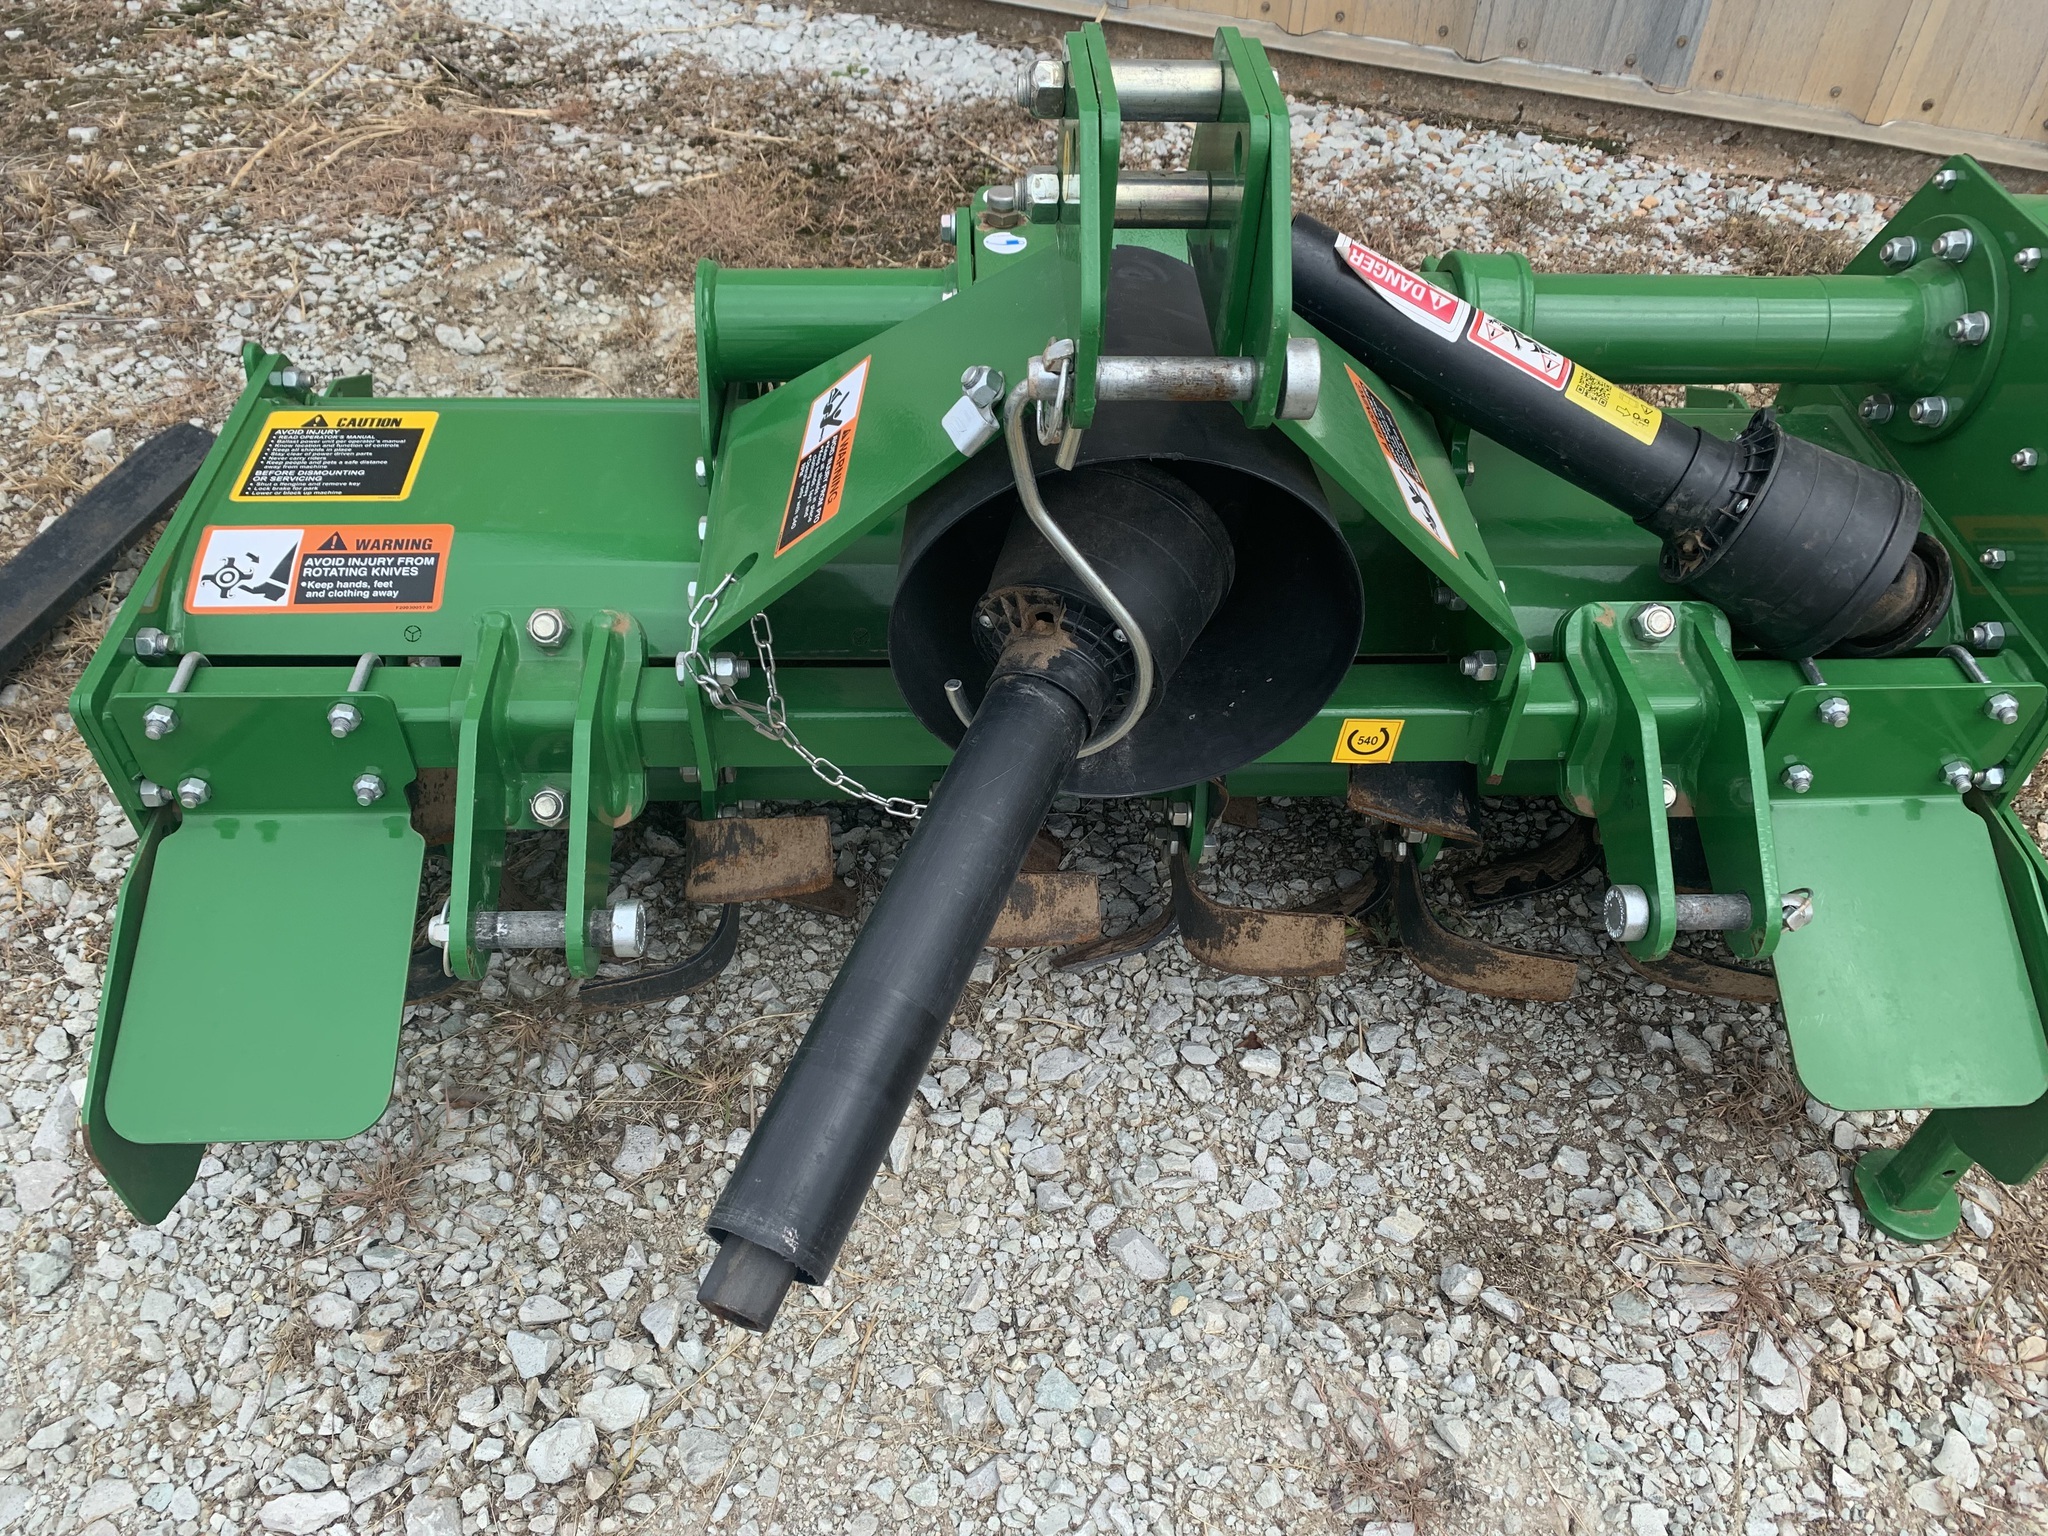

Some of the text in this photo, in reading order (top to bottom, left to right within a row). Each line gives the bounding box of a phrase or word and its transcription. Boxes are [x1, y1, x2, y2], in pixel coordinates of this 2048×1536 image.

[1349, 247, 1427, 301] DANGER
[336, 418, 402, 427] CAUTION
[827, 437, 848, 505] WARNING
[356, 538, 433, 550] WARNING
[304, 557, 435, 566] AVOID INJURY FROM
[303, 567, 419, 577] ROTATING KNIVES
[307, 580, 393, 589] Keep hands, feet
[327, 590, 369, 598] clothing
[1357, 736, 1379, 745] 540
